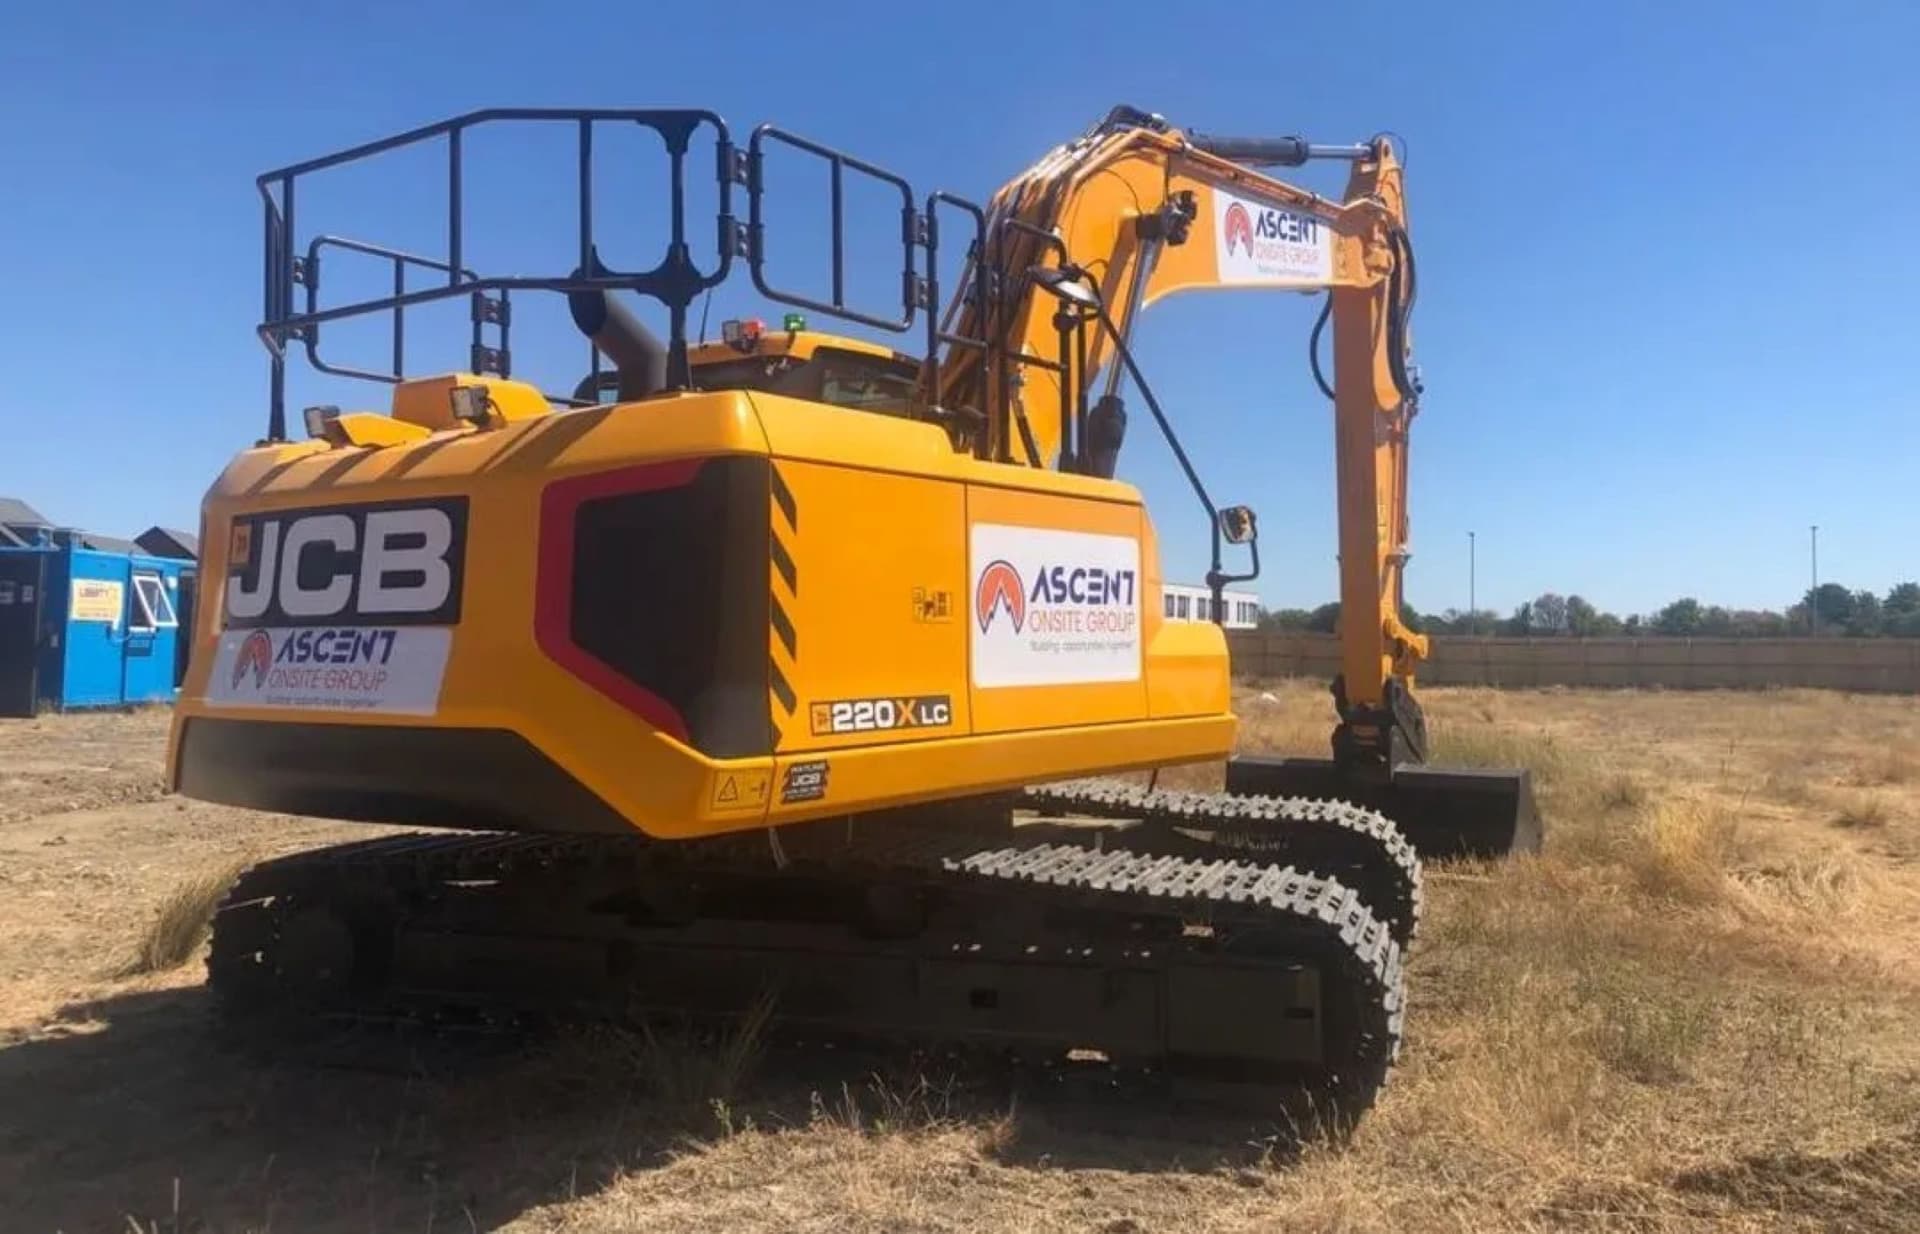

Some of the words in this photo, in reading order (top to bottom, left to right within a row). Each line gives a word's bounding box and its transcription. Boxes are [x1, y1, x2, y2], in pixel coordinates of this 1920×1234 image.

[1255, 209, 1317, 245] ASCENT
[227, 508, 452, 618] JCB
[1030, 565, 1134, 605] ASCENT
[1030, 610, 1083, 632] ONSITE
[1086, 611, 1136, 633] GROUP
[275, 630, 397, 664] ASCENT
[268, 669, 322, 689] ONSITE
[323, 669, 388, 691] GROUP
[792, 773, 820, 787] JCB
